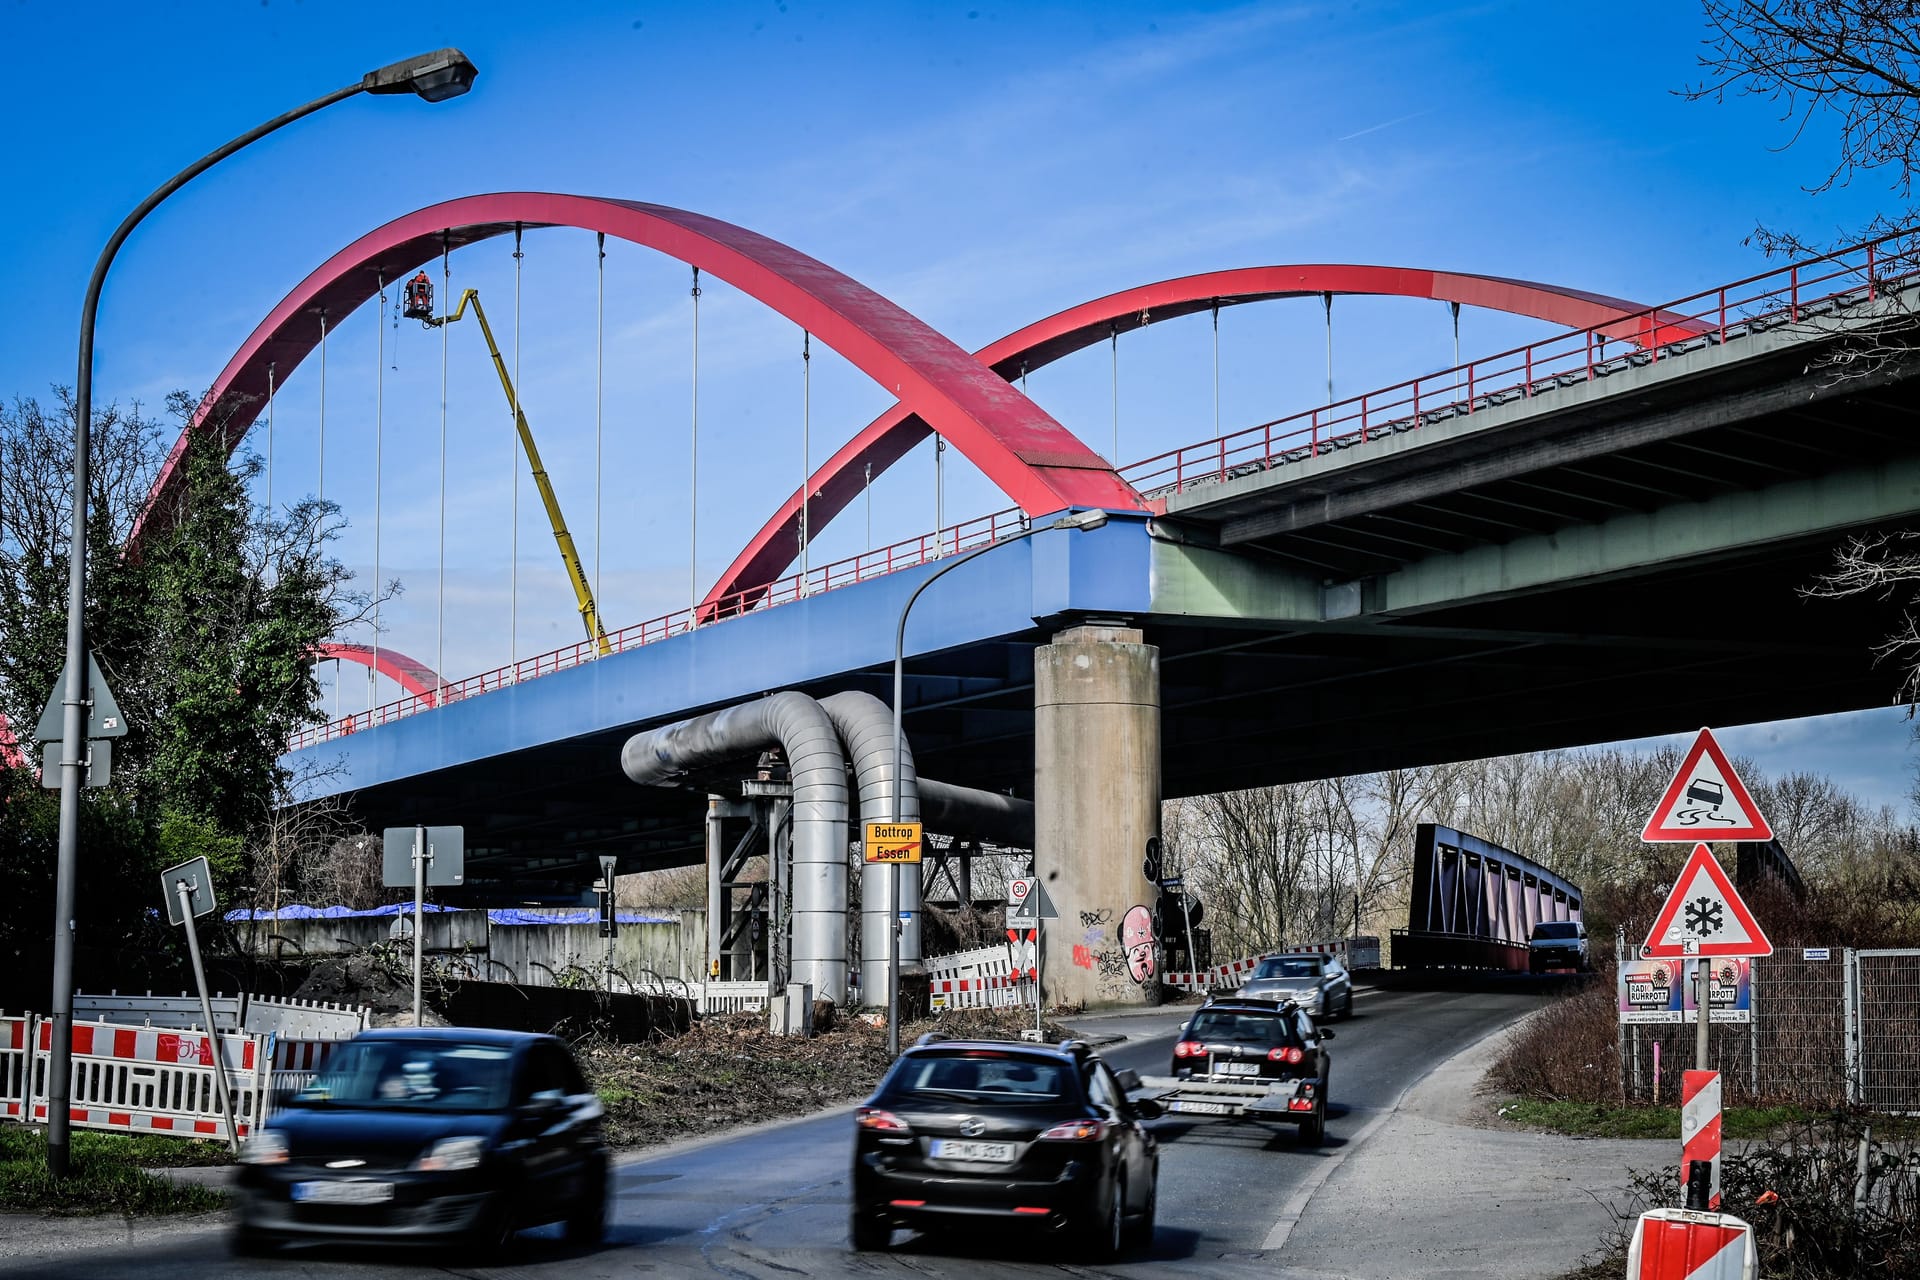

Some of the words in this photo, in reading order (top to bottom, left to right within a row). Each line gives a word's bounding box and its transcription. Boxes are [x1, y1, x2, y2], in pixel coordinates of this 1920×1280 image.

[875, 826, 913, 841] Bottrop
[877, 846, 910, 860] Essen
[1015, 885, 1025, 894] 30
[1631, 984, 1652, 993] RADIO
[1631, 992, 1667, 1000] RUHRPOTT
